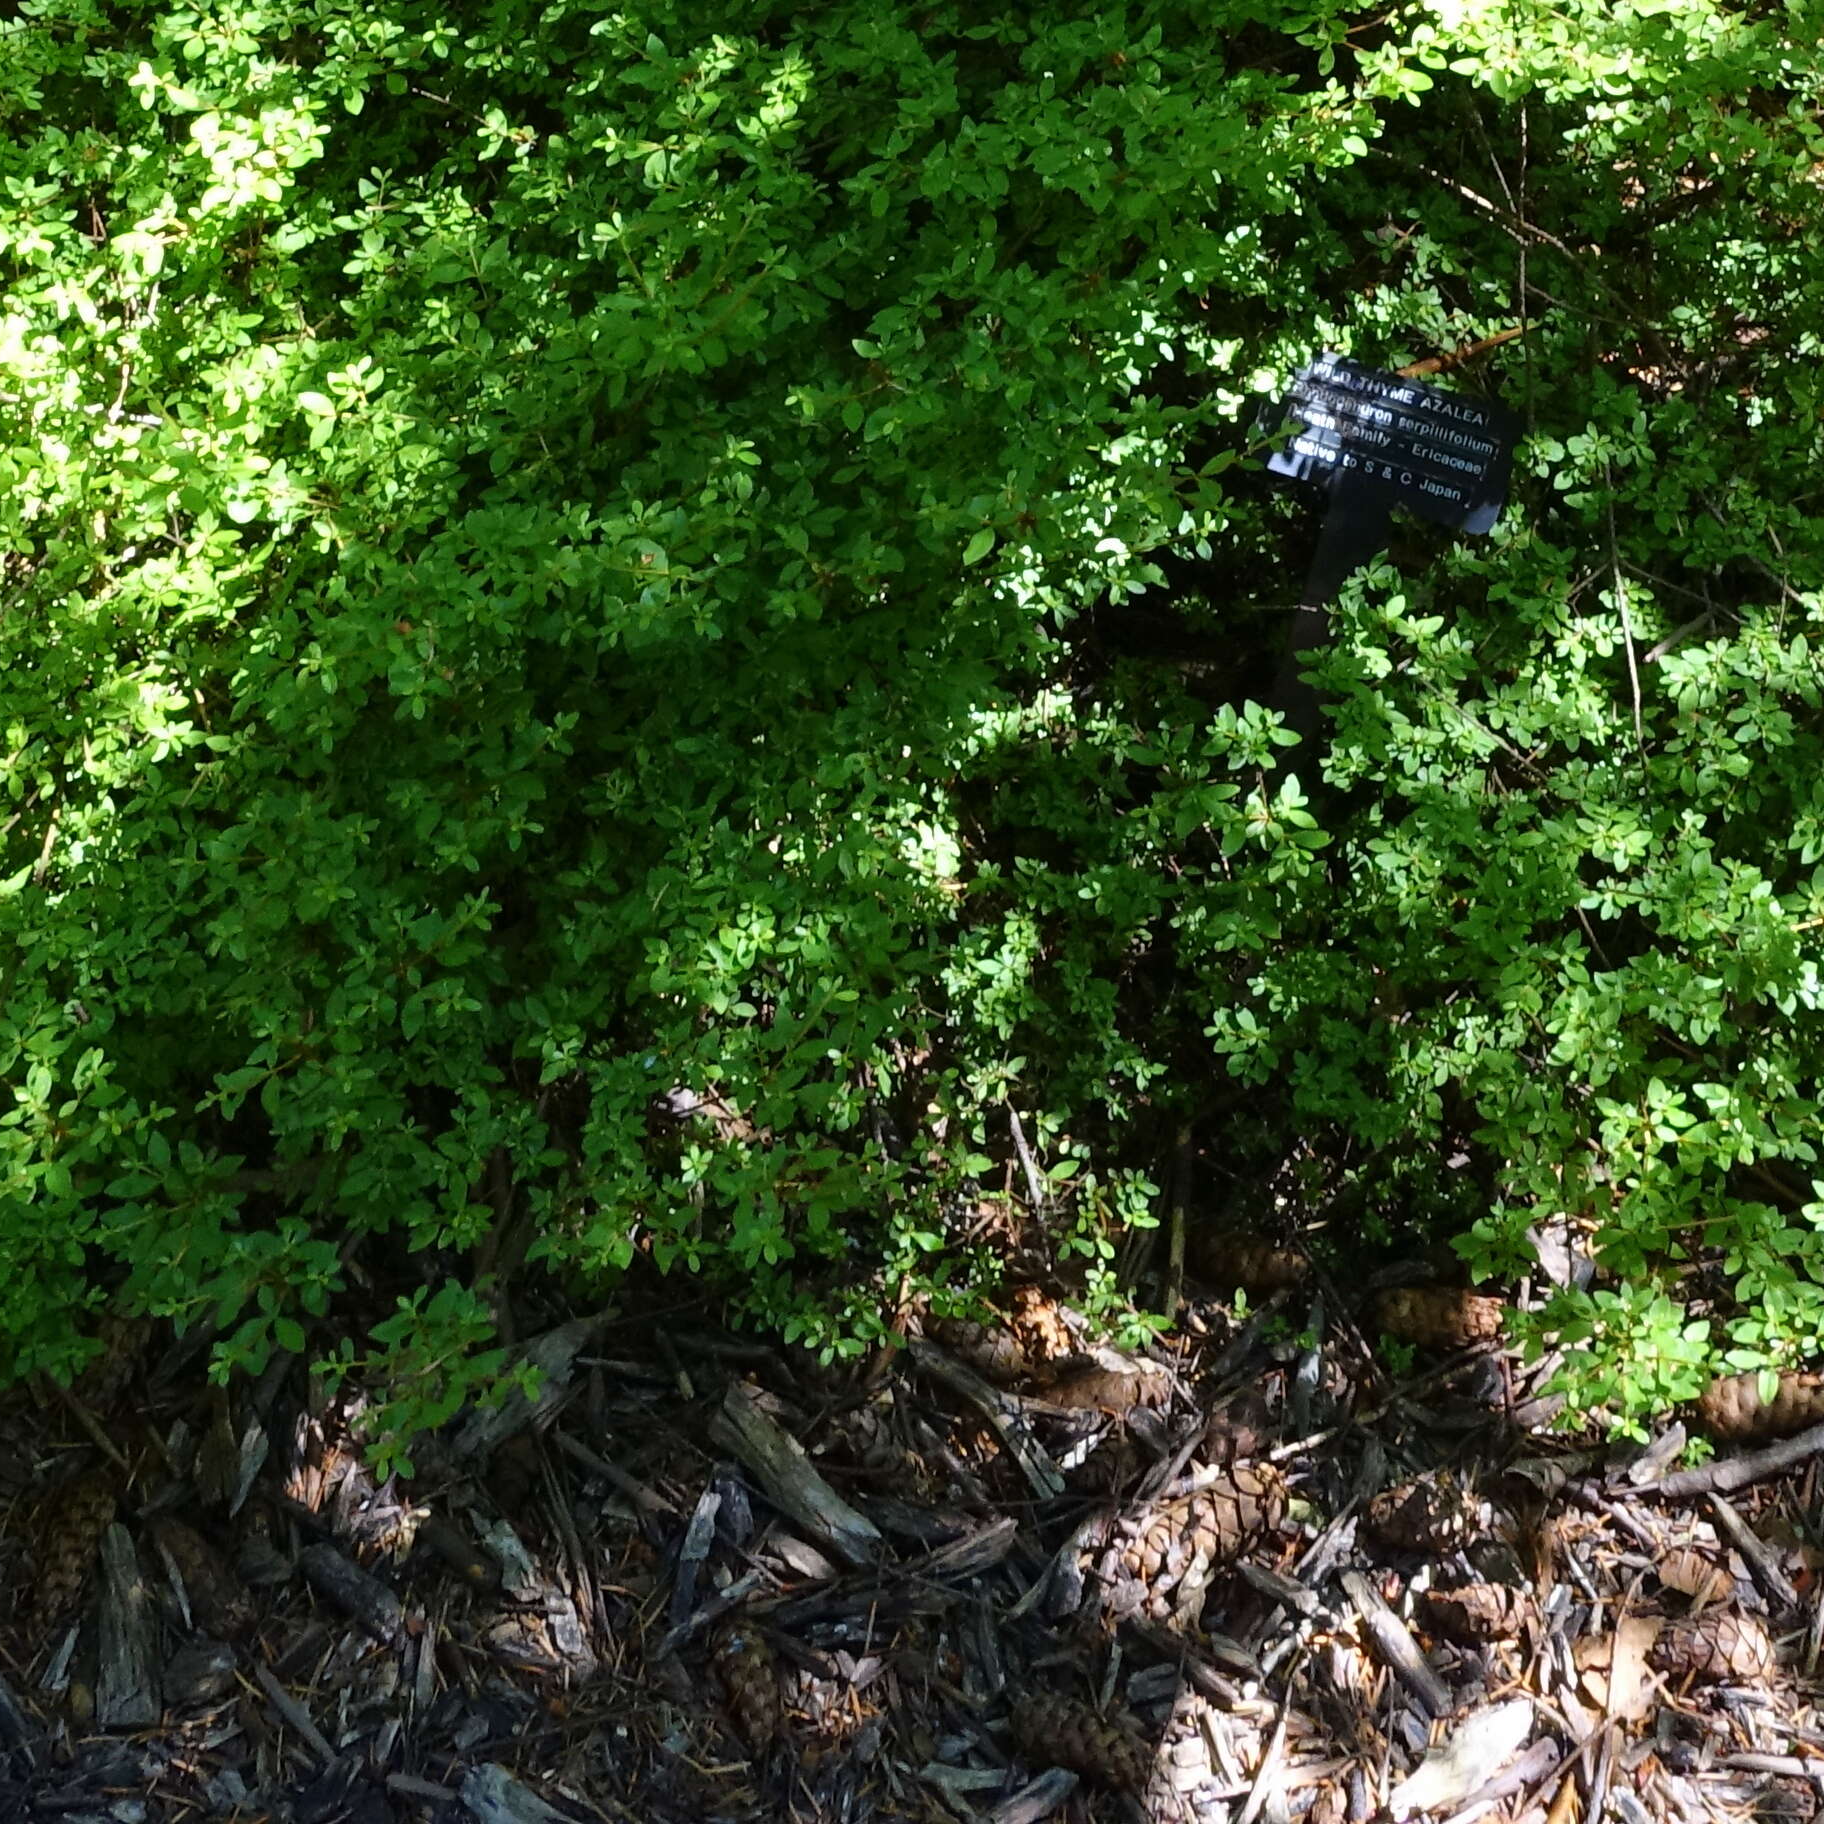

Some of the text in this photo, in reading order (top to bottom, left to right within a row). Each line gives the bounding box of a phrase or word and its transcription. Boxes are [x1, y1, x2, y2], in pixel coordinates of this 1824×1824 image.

[1313, 362, 1483, 426] WILD THYME AZALEA
[1342, 454, 1358, 468] to
[1364, 461, 1375, 473] S
[1382, 466, 1392, 479] &
[1400, 472, 1412, 485] C
[1419, 479, 1462, 501] Japan
[1411, 443, 1482, 475] Ericaceae
